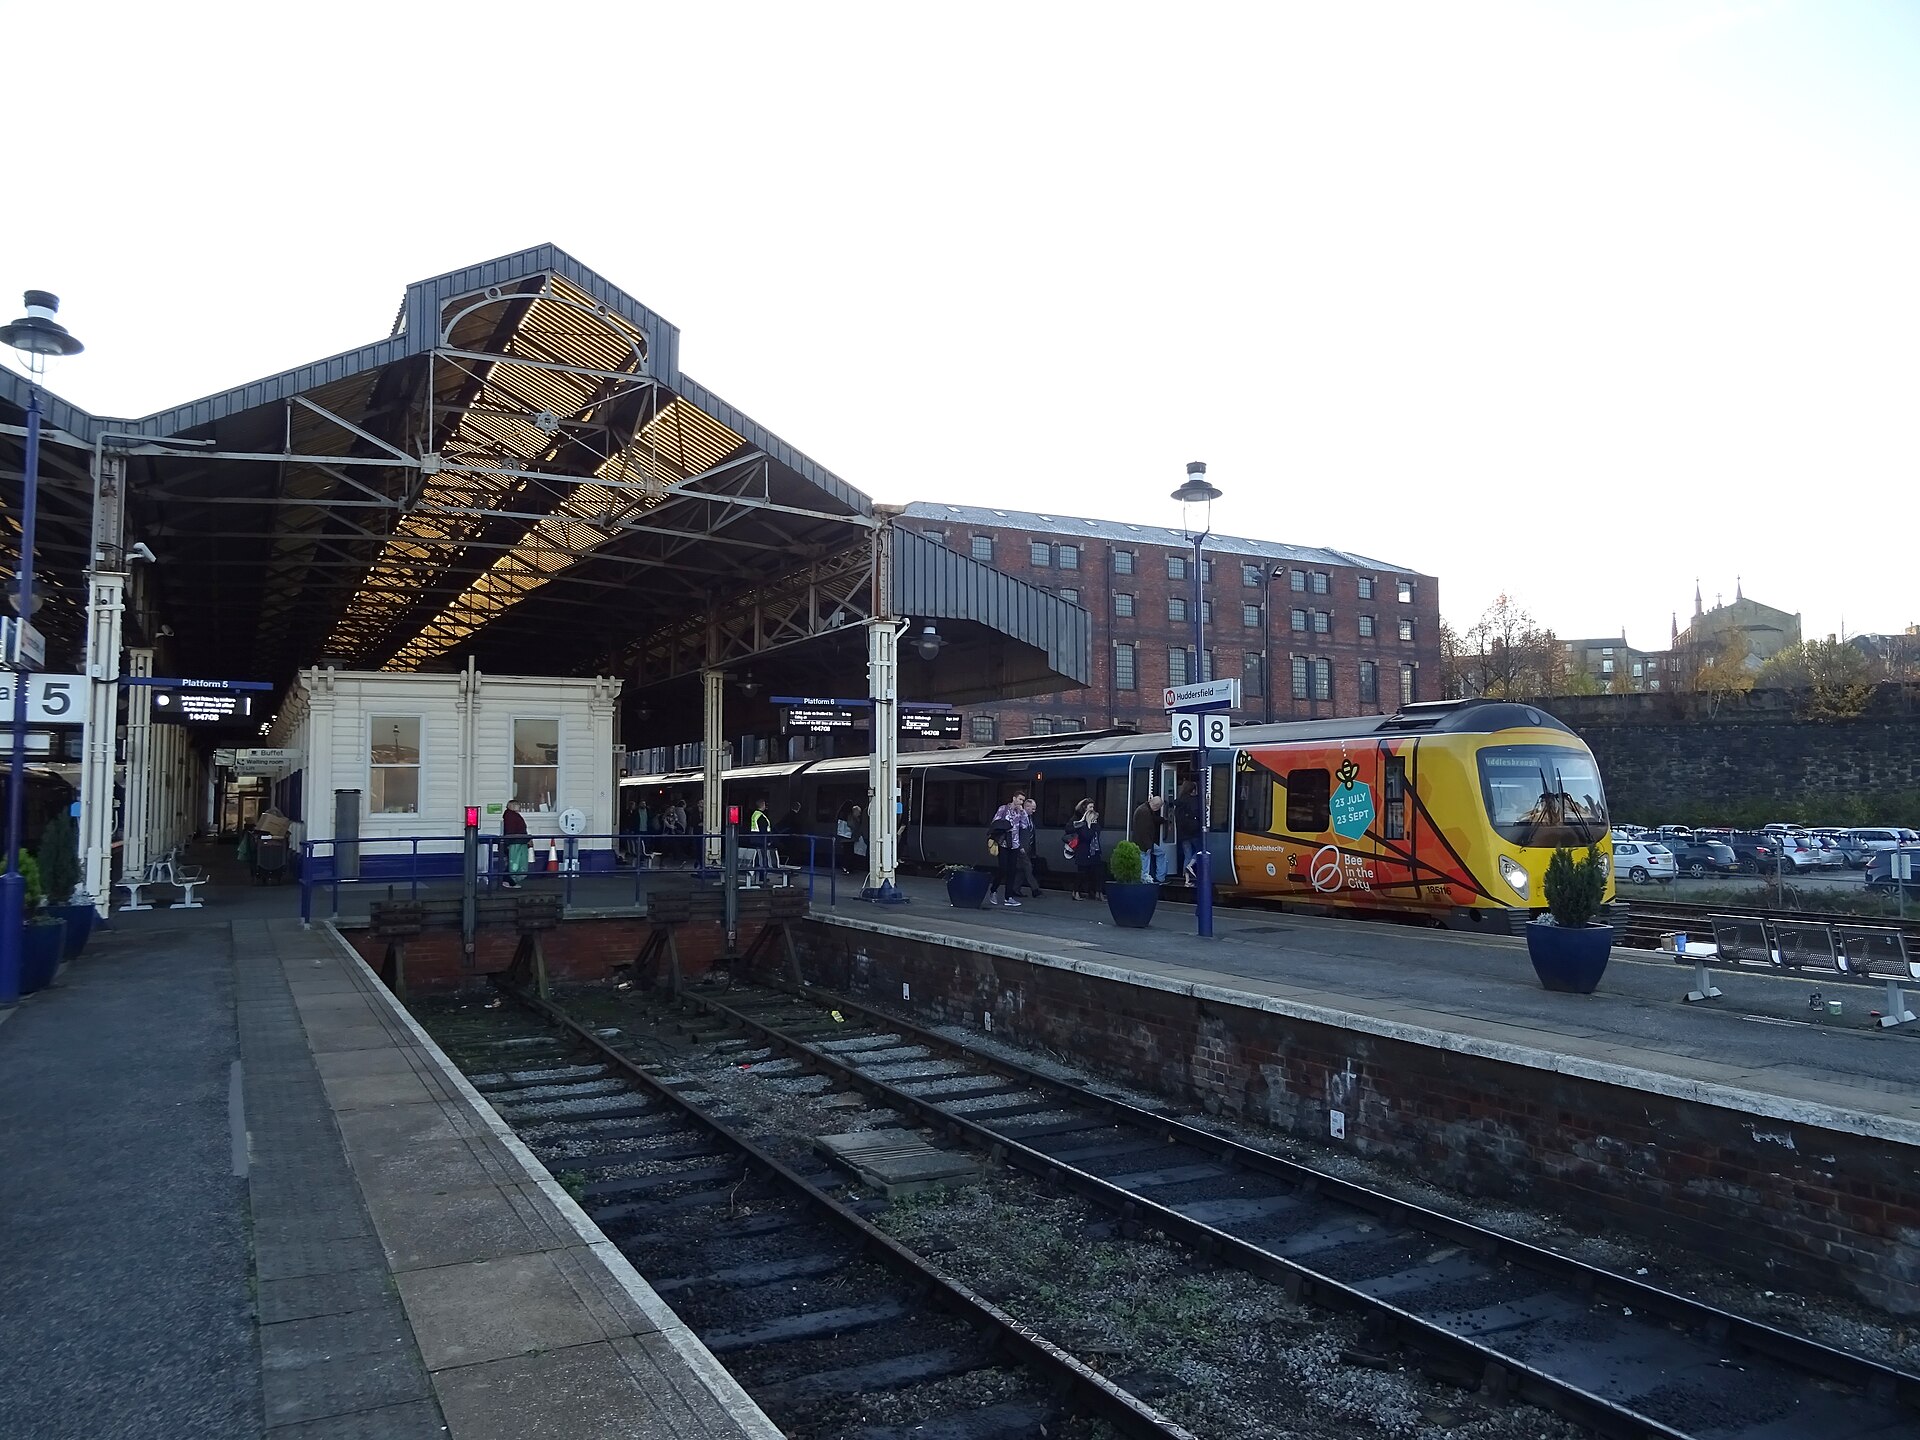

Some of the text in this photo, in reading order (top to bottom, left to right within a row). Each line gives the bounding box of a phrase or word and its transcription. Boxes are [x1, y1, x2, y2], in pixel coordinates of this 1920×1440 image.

[182, 679, 220, 688] Platform
[42, 682, 71, 716] 5
[1177, 688, 1214, 701] Huddersfield
[1178, 719, 1193, 742] 6
[1210, 720, 1224, 743] 8
[1335, 792, 1366, 808] 23 JULY
[1336, 809, 1369, 825] 23 SEPT
[1344, 854, 1363, 866] Bee
[1345, 865, 1374, 879] in the
[1347, 877, 1371, 892] City
[1426, 885, 1452, 896] 185116
